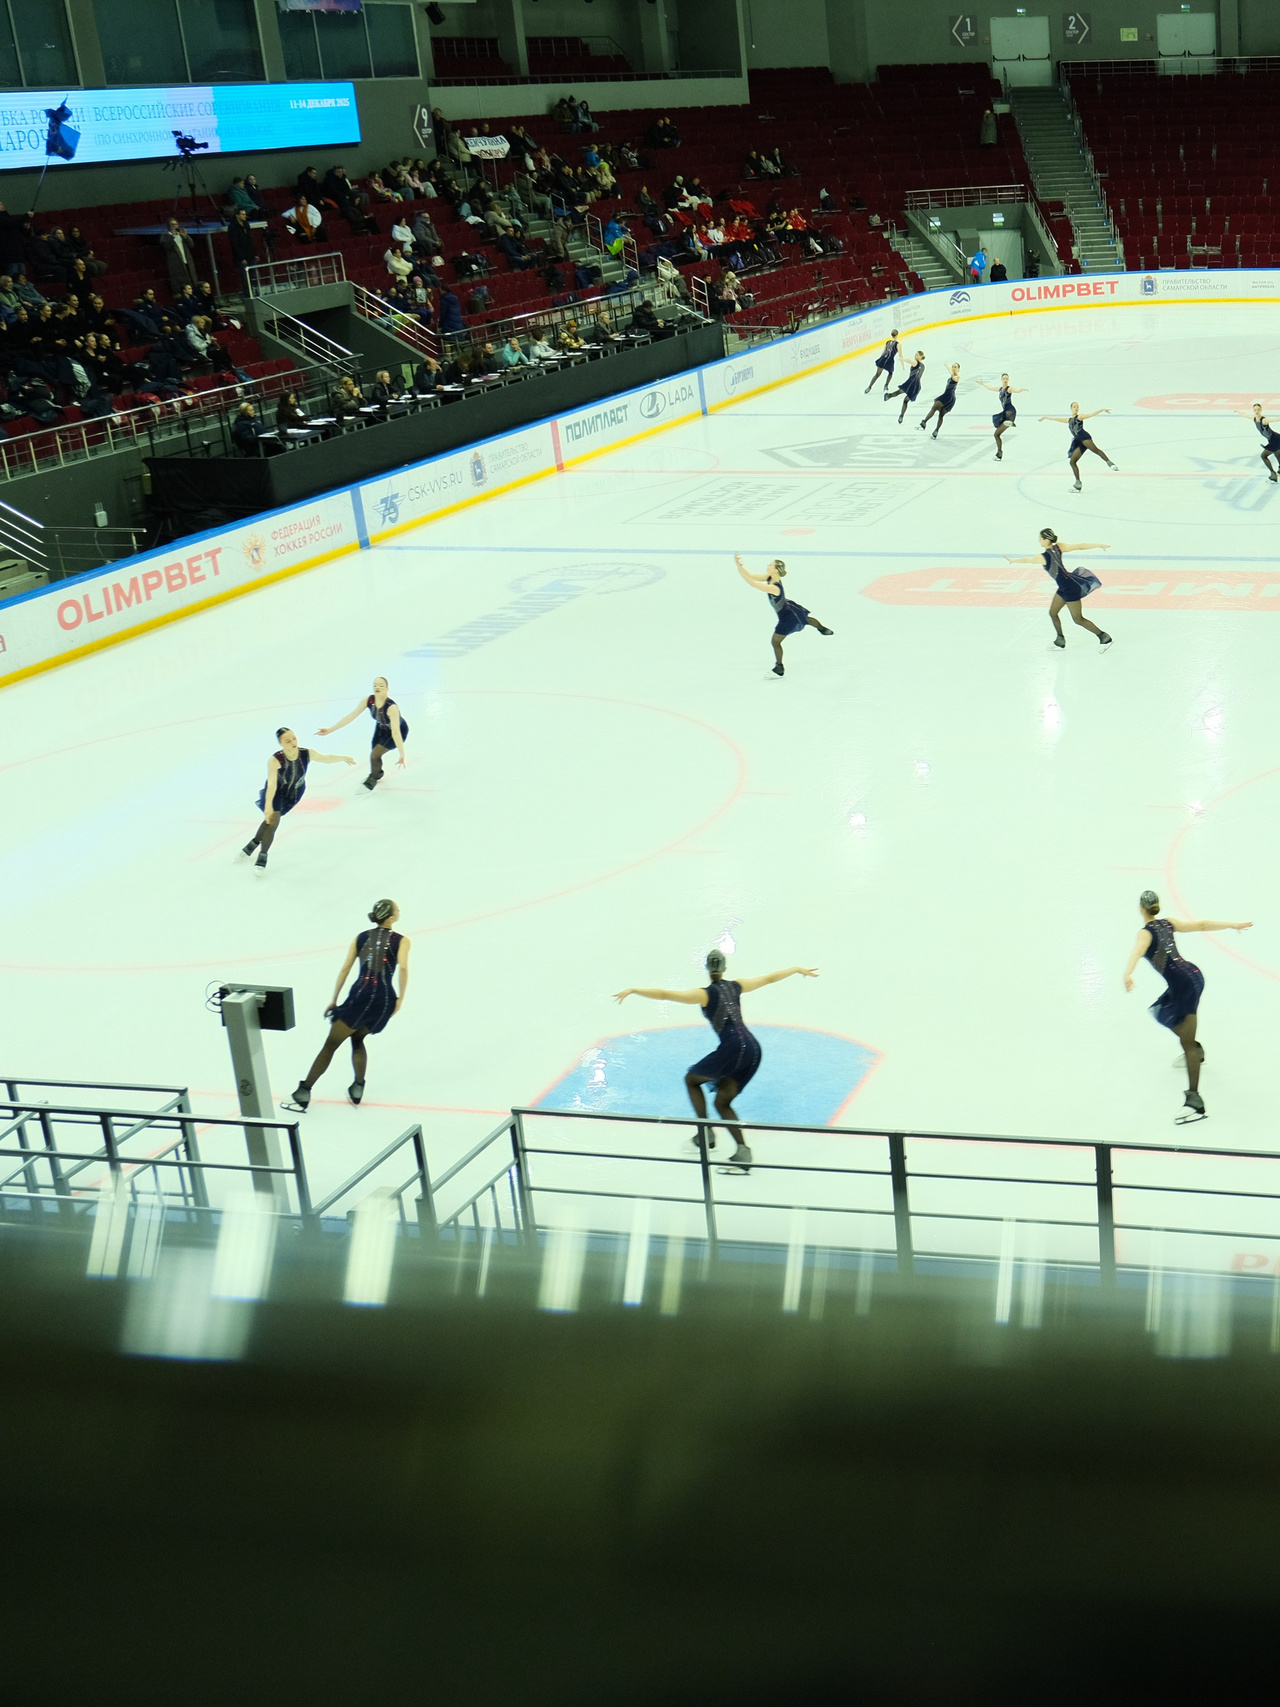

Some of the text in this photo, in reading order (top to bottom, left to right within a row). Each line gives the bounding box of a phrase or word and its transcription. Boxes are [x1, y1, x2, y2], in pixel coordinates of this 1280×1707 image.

[965, 18, 971, 31] 1
[1068, 16, 1076, 30] 2
[93, 101, 195, 121] ВСЕРОССИЙСКИЕ
[421, 108, 428, 127] 9
[1011, 280, 1119, 301] OLIMPBET
[669, 385, 694, 406] LADA
[565, 404, 629, 442] ПОЛИПЛАСТ
[407, 470, 463, 502] CSK-VVS.RU
[271, 515, 321, 540] ФЕДЕРАЦИЯ
[273, 523, 343, 558] ХОККЕЯ РОССИИ
[56, 547, 222, 631] OLIMPBET
